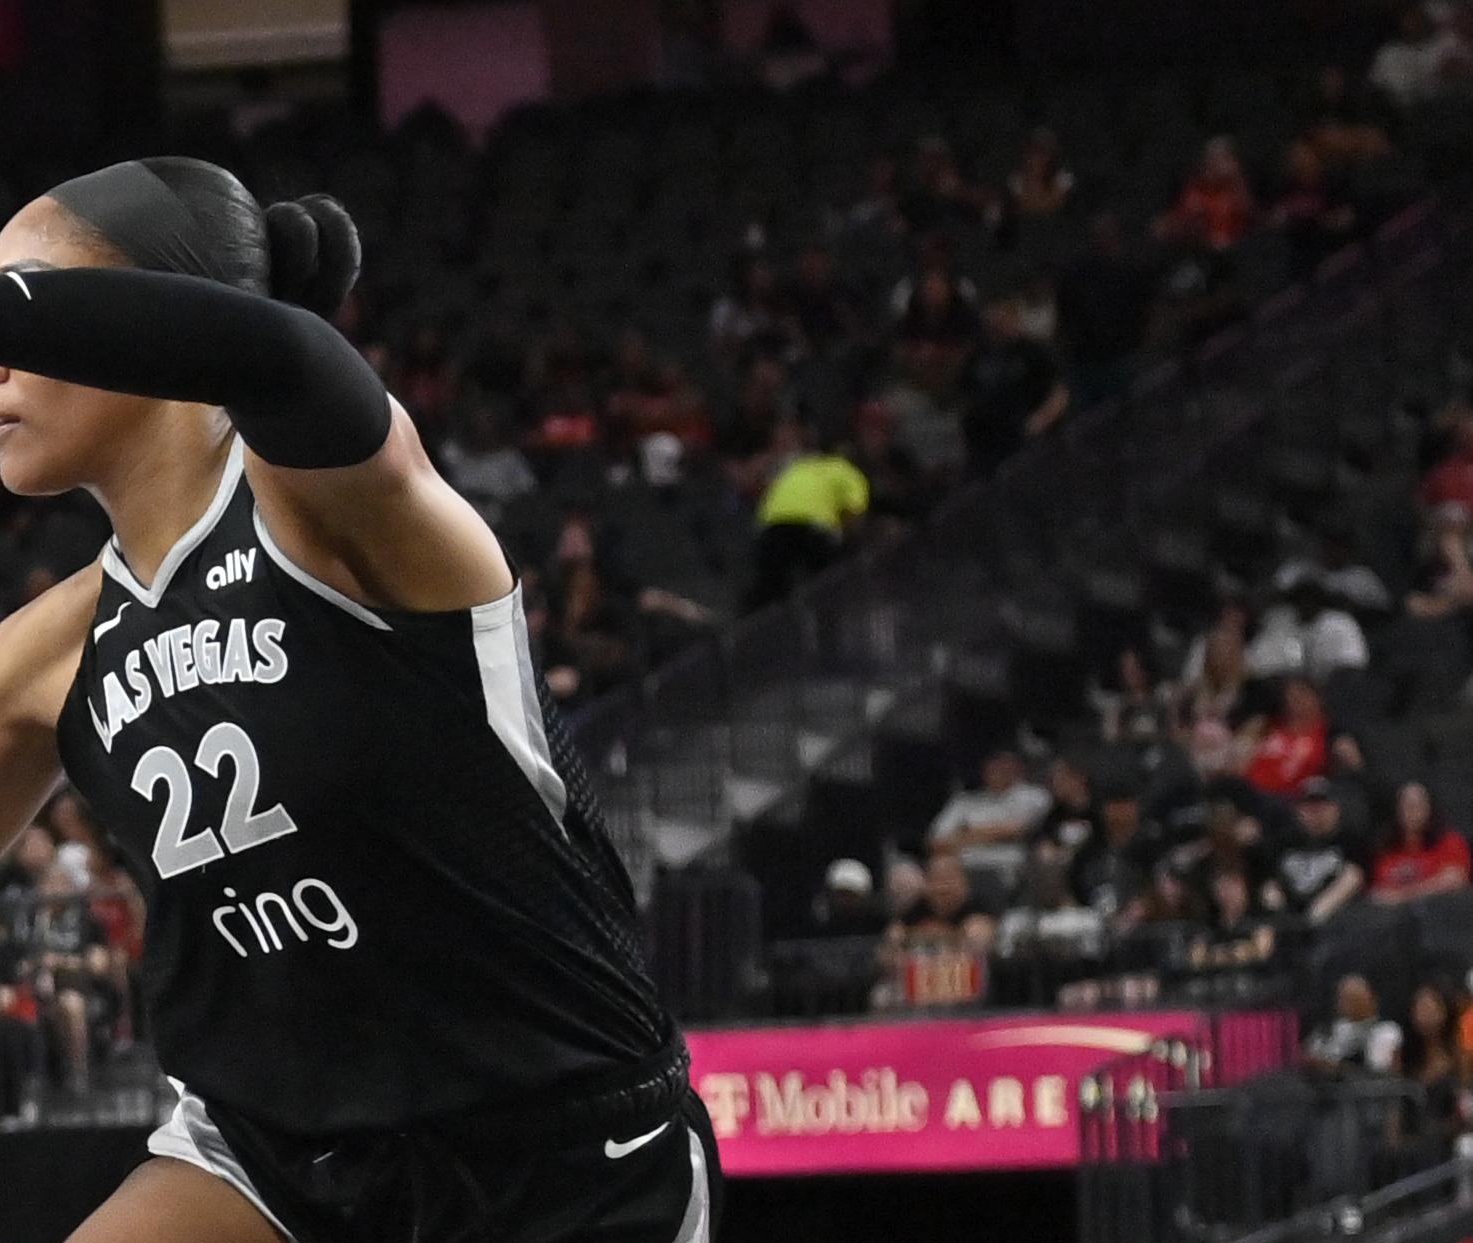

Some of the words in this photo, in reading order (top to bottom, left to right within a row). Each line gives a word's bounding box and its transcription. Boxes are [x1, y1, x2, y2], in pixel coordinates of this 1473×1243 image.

[206, 547, 257, 591] ally
[143, 618, 289, 698] VEGAS
[130, 722, 298, 880] 22
[212, 877, 359, 957] ring
[757, 1066, 930, 1135] Mobile
